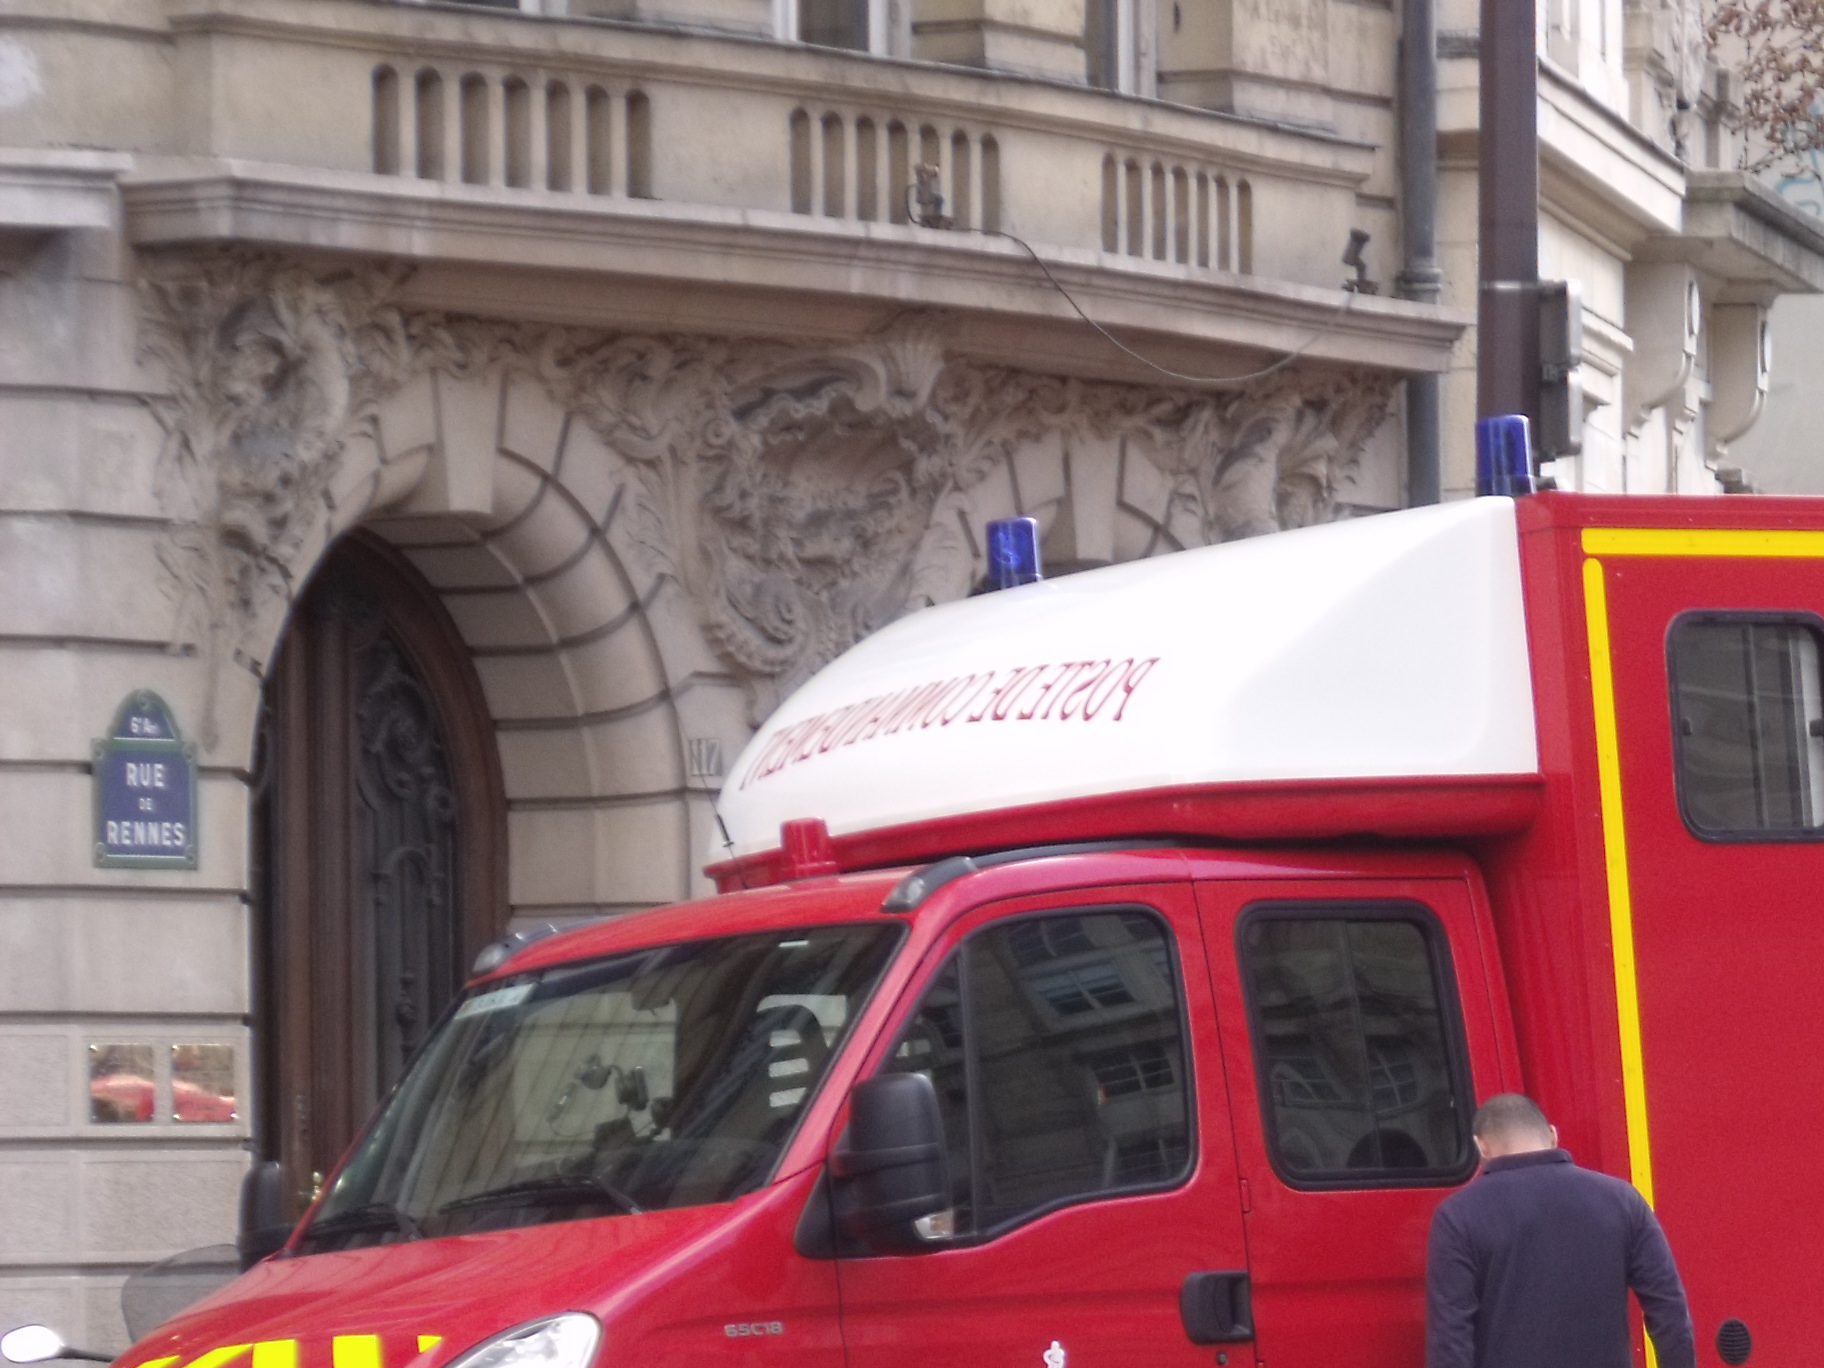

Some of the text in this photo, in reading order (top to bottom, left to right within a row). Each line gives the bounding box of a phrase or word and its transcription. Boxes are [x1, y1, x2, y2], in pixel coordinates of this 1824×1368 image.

[126, 762, 165, 787] RUE
[139, 797, 152, 810] DE
[107, 820, 185, 845] RENNES
